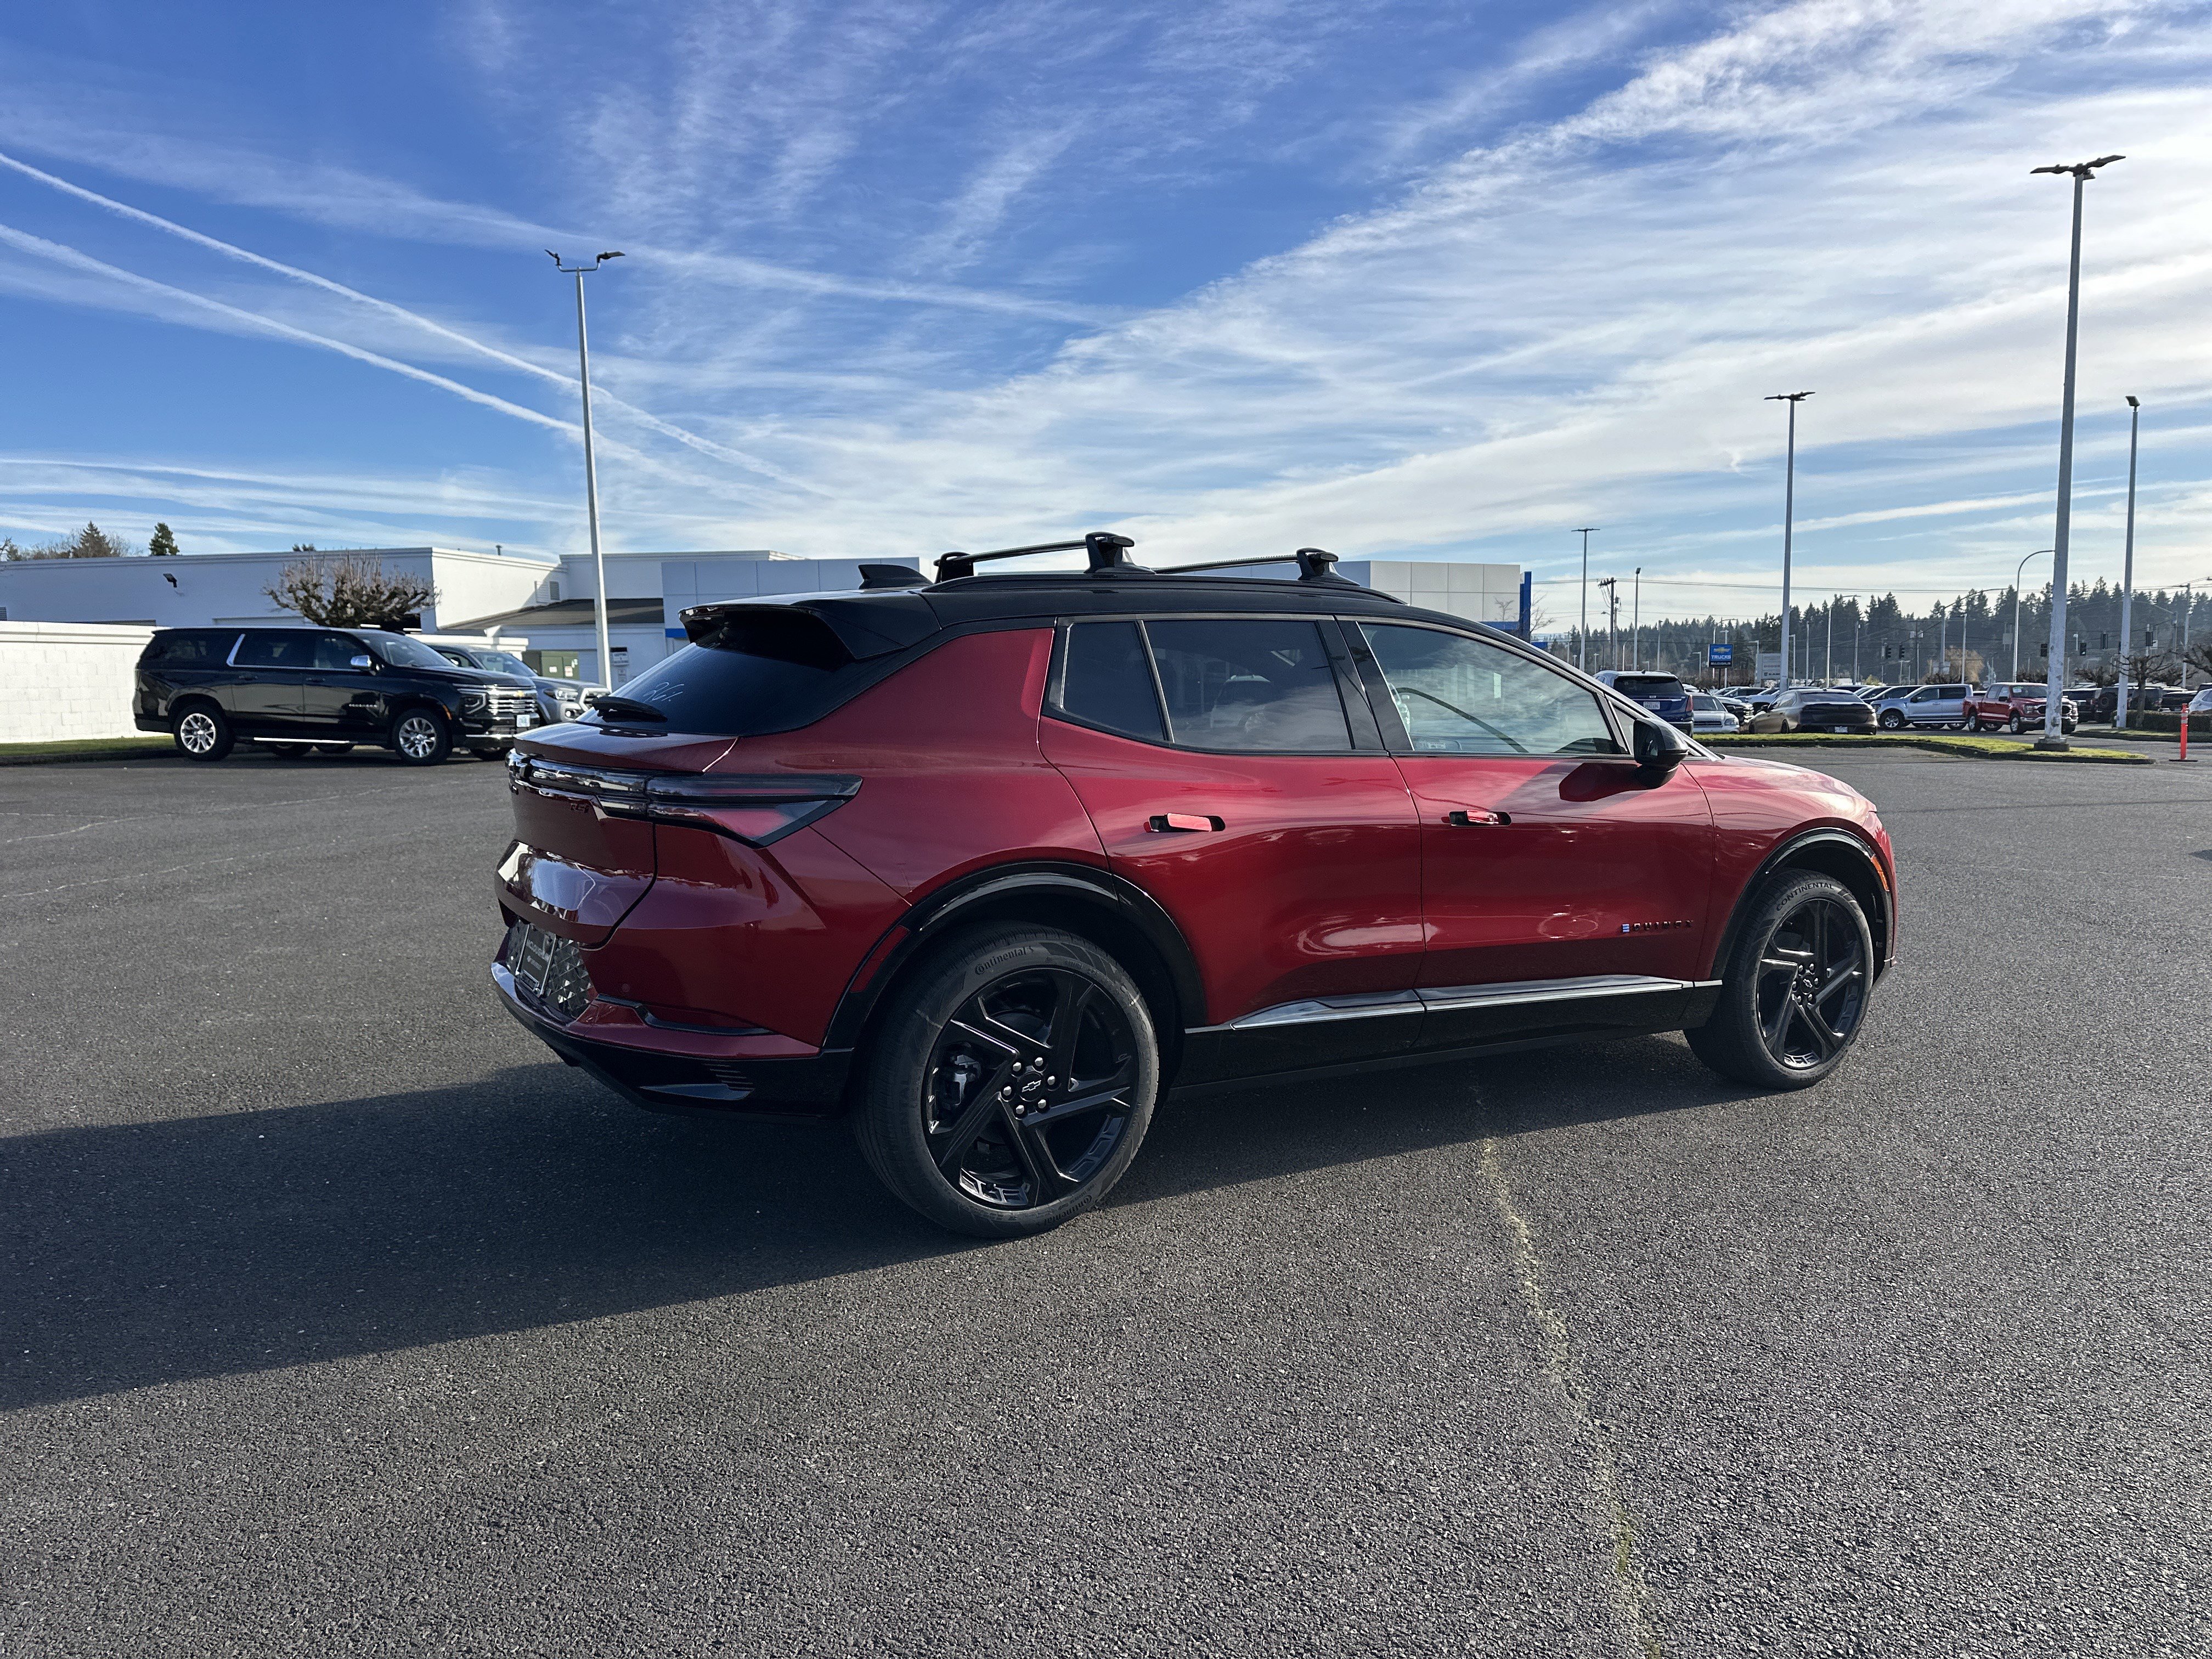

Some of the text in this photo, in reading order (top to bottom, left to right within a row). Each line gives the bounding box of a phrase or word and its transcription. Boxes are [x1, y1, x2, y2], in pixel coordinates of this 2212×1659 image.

[1776, 882, 1835, 911] CONTINENTAL
[1622, 919, 1694, 933] EQUINOX
[974, 946, 1027, 975] Continental
